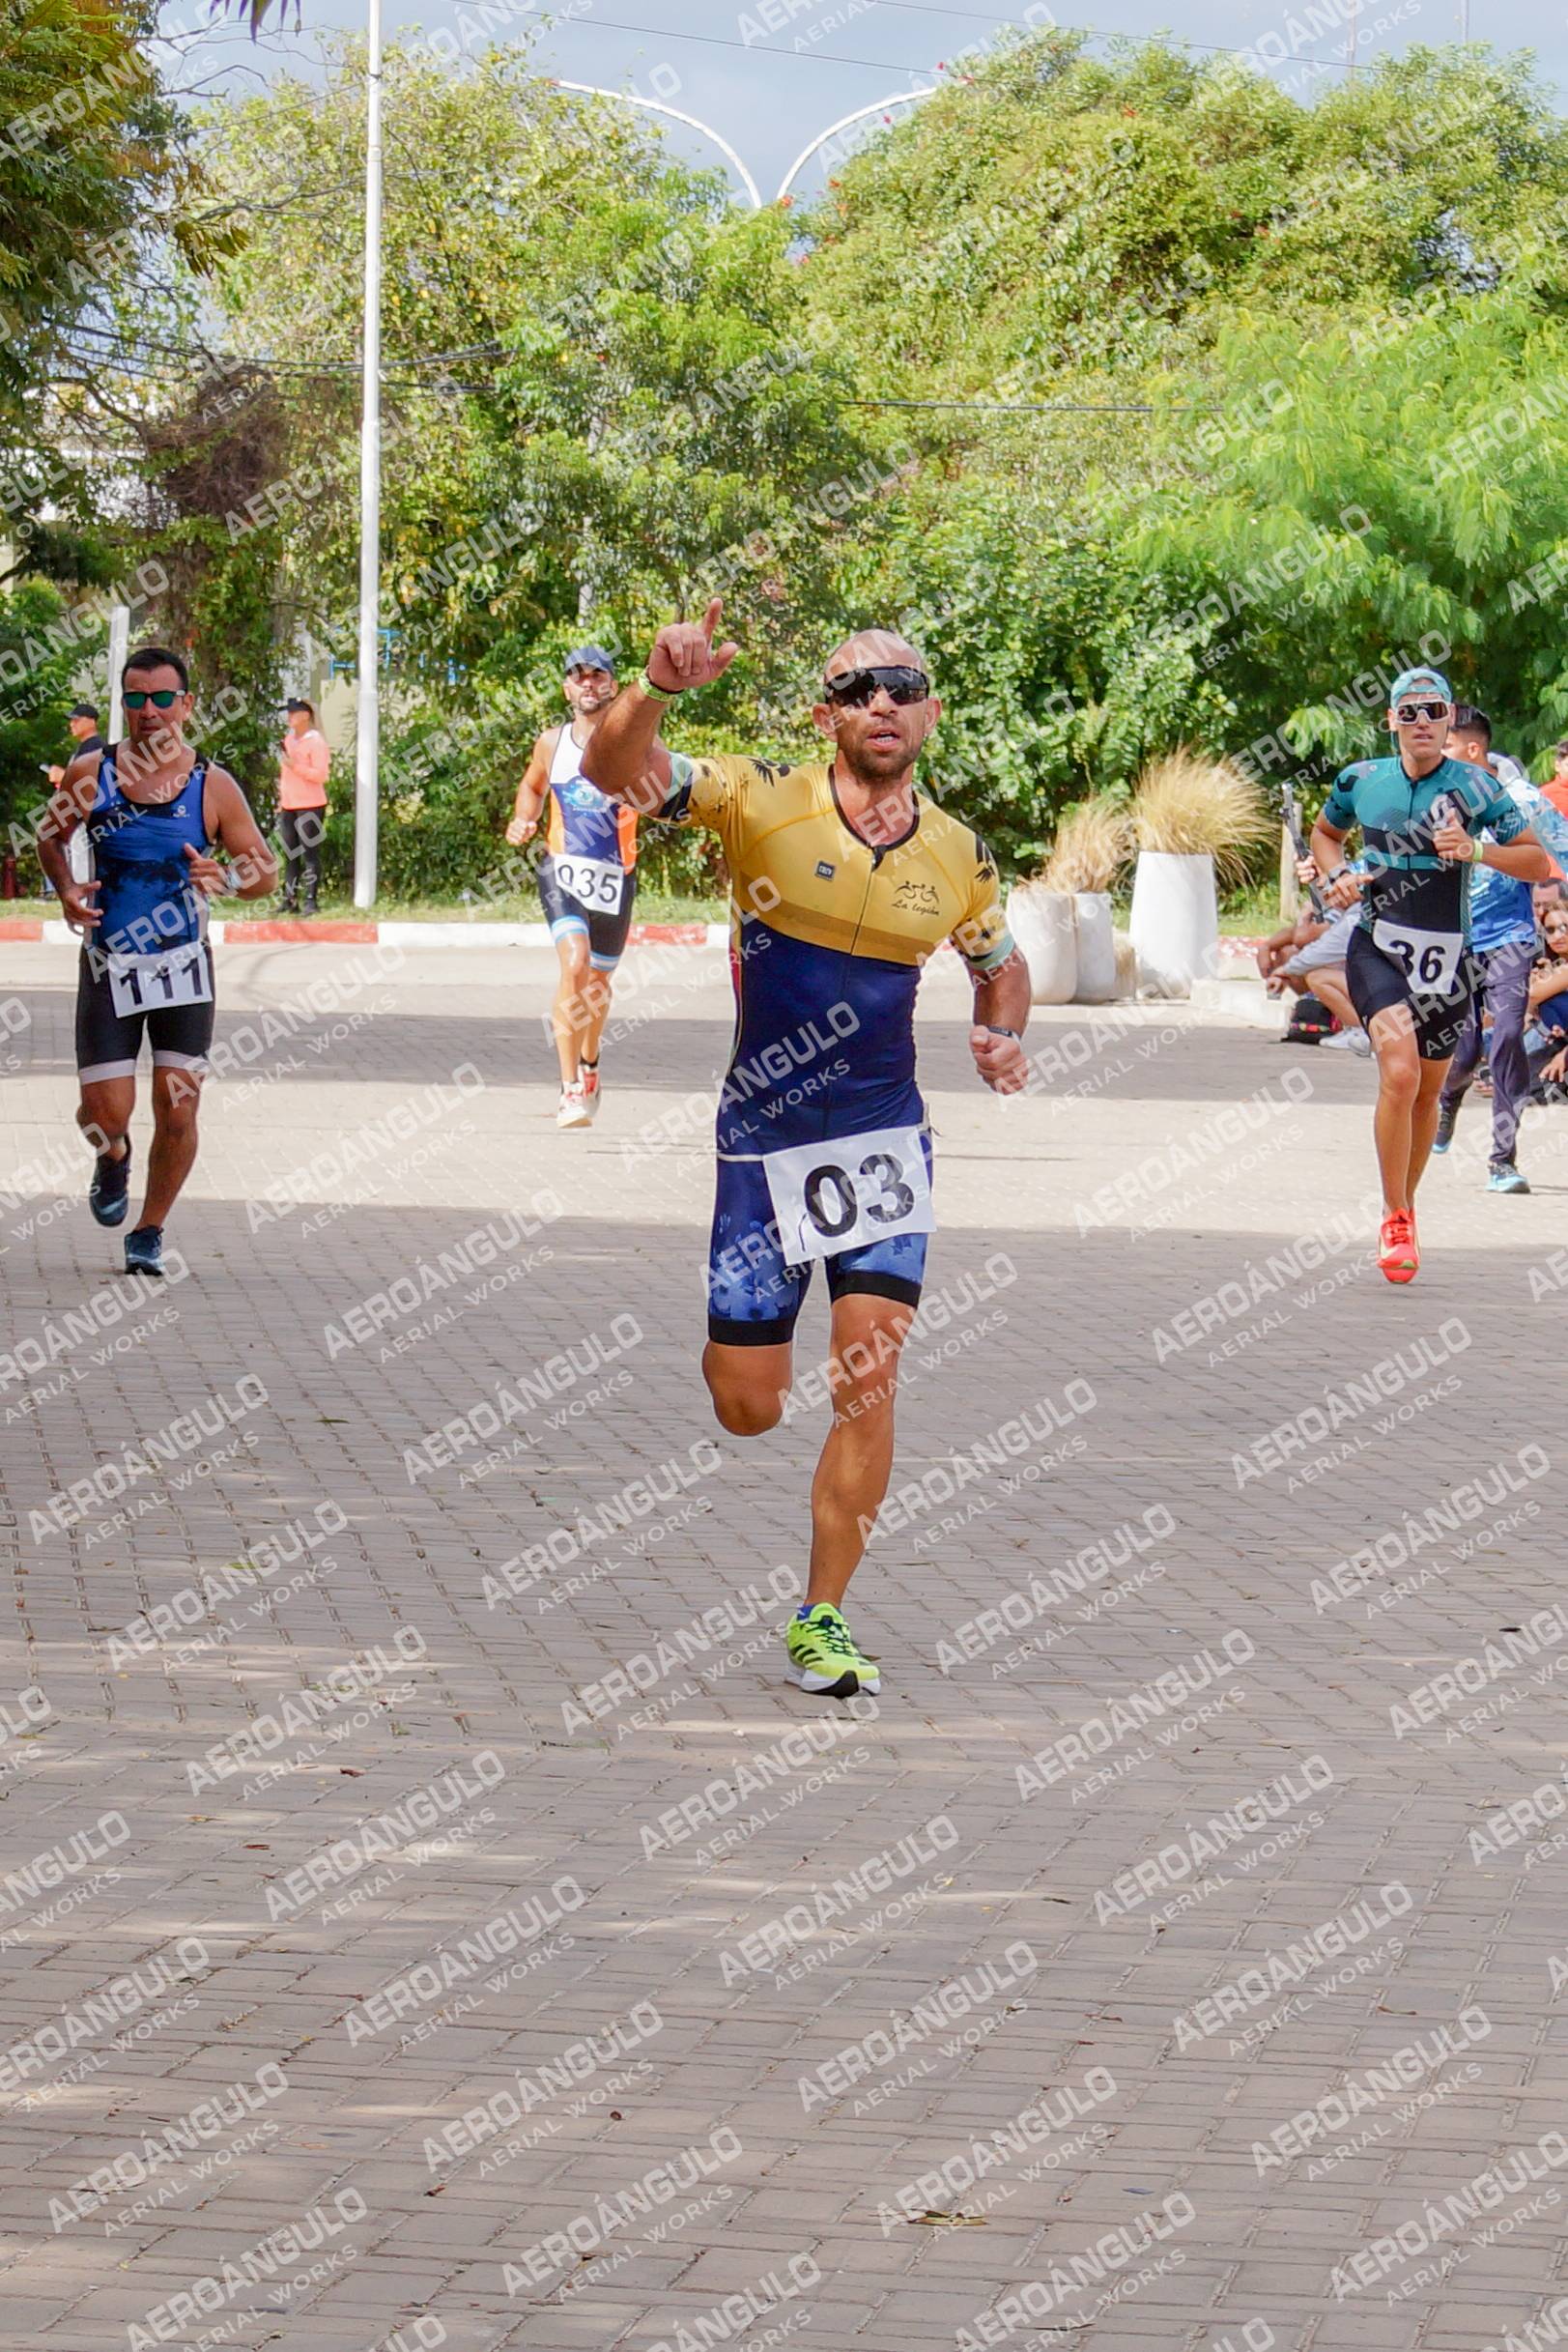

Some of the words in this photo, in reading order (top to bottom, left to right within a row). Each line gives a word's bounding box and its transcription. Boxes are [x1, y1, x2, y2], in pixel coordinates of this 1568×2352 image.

[557, 864, 619, 904] 035
[119, 958, 203, 1006] 111
[804, 1153, 915, 1238] 03
